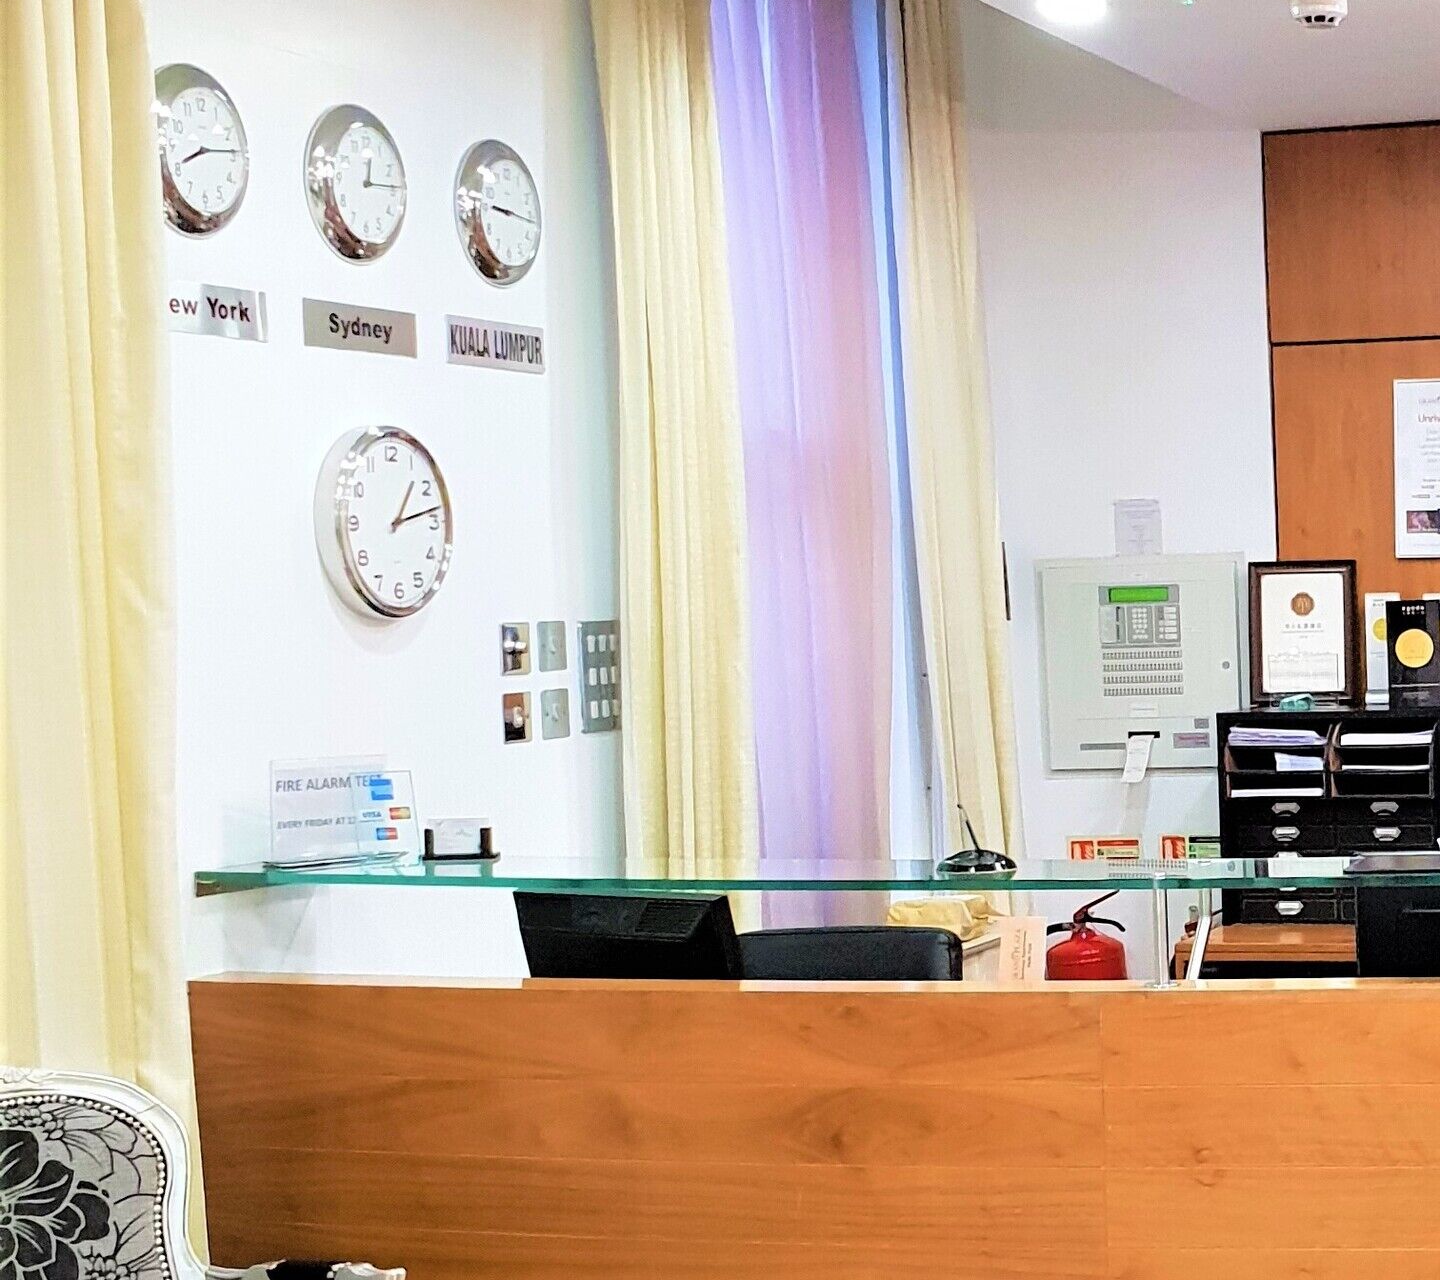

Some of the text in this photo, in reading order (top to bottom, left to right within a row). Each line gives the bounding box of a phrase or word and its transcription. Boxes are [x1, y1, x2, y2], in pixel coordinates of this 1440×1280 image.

[183, 102, 192, 117] 11
[195, 97, 206, 113] 12
[214, 107, 218, 120] 1
[172, 119, 184, 134] 10
[224, 126, 233, 141] 2
[174, 162, 181, 177] 8
[226, 172, 234, 184] 4
[186, 181, 193, 195] 7
[216, 186, 223, 200] 5
[202, 193, 209, 204] 6
[169, 296, 250, 322] ew York
[328, 312, 393, 344] Sydney
[450, 324, 543, 365] KUALA LUMPUR
[384, 445, 398, 462] 12
[366, 455, 375, 472] 11
[410, 455, 413, 470] 1
[354, 482, 364, 498] 10
[421, 480, 431, 496] 2
[348, 515, 359, 531] 9
[429, 514, 440, 530] 3
[358, 550, 369, 566] 8
[425, 546, 435, 560] 4
[374, 574, 383, 591] 7
[413, 572, 424, 588] 5
[394, 582, 404, 599] 6
[275, 779, 303, 793] FIRE
[306, 776, 351, 791] ALARM
